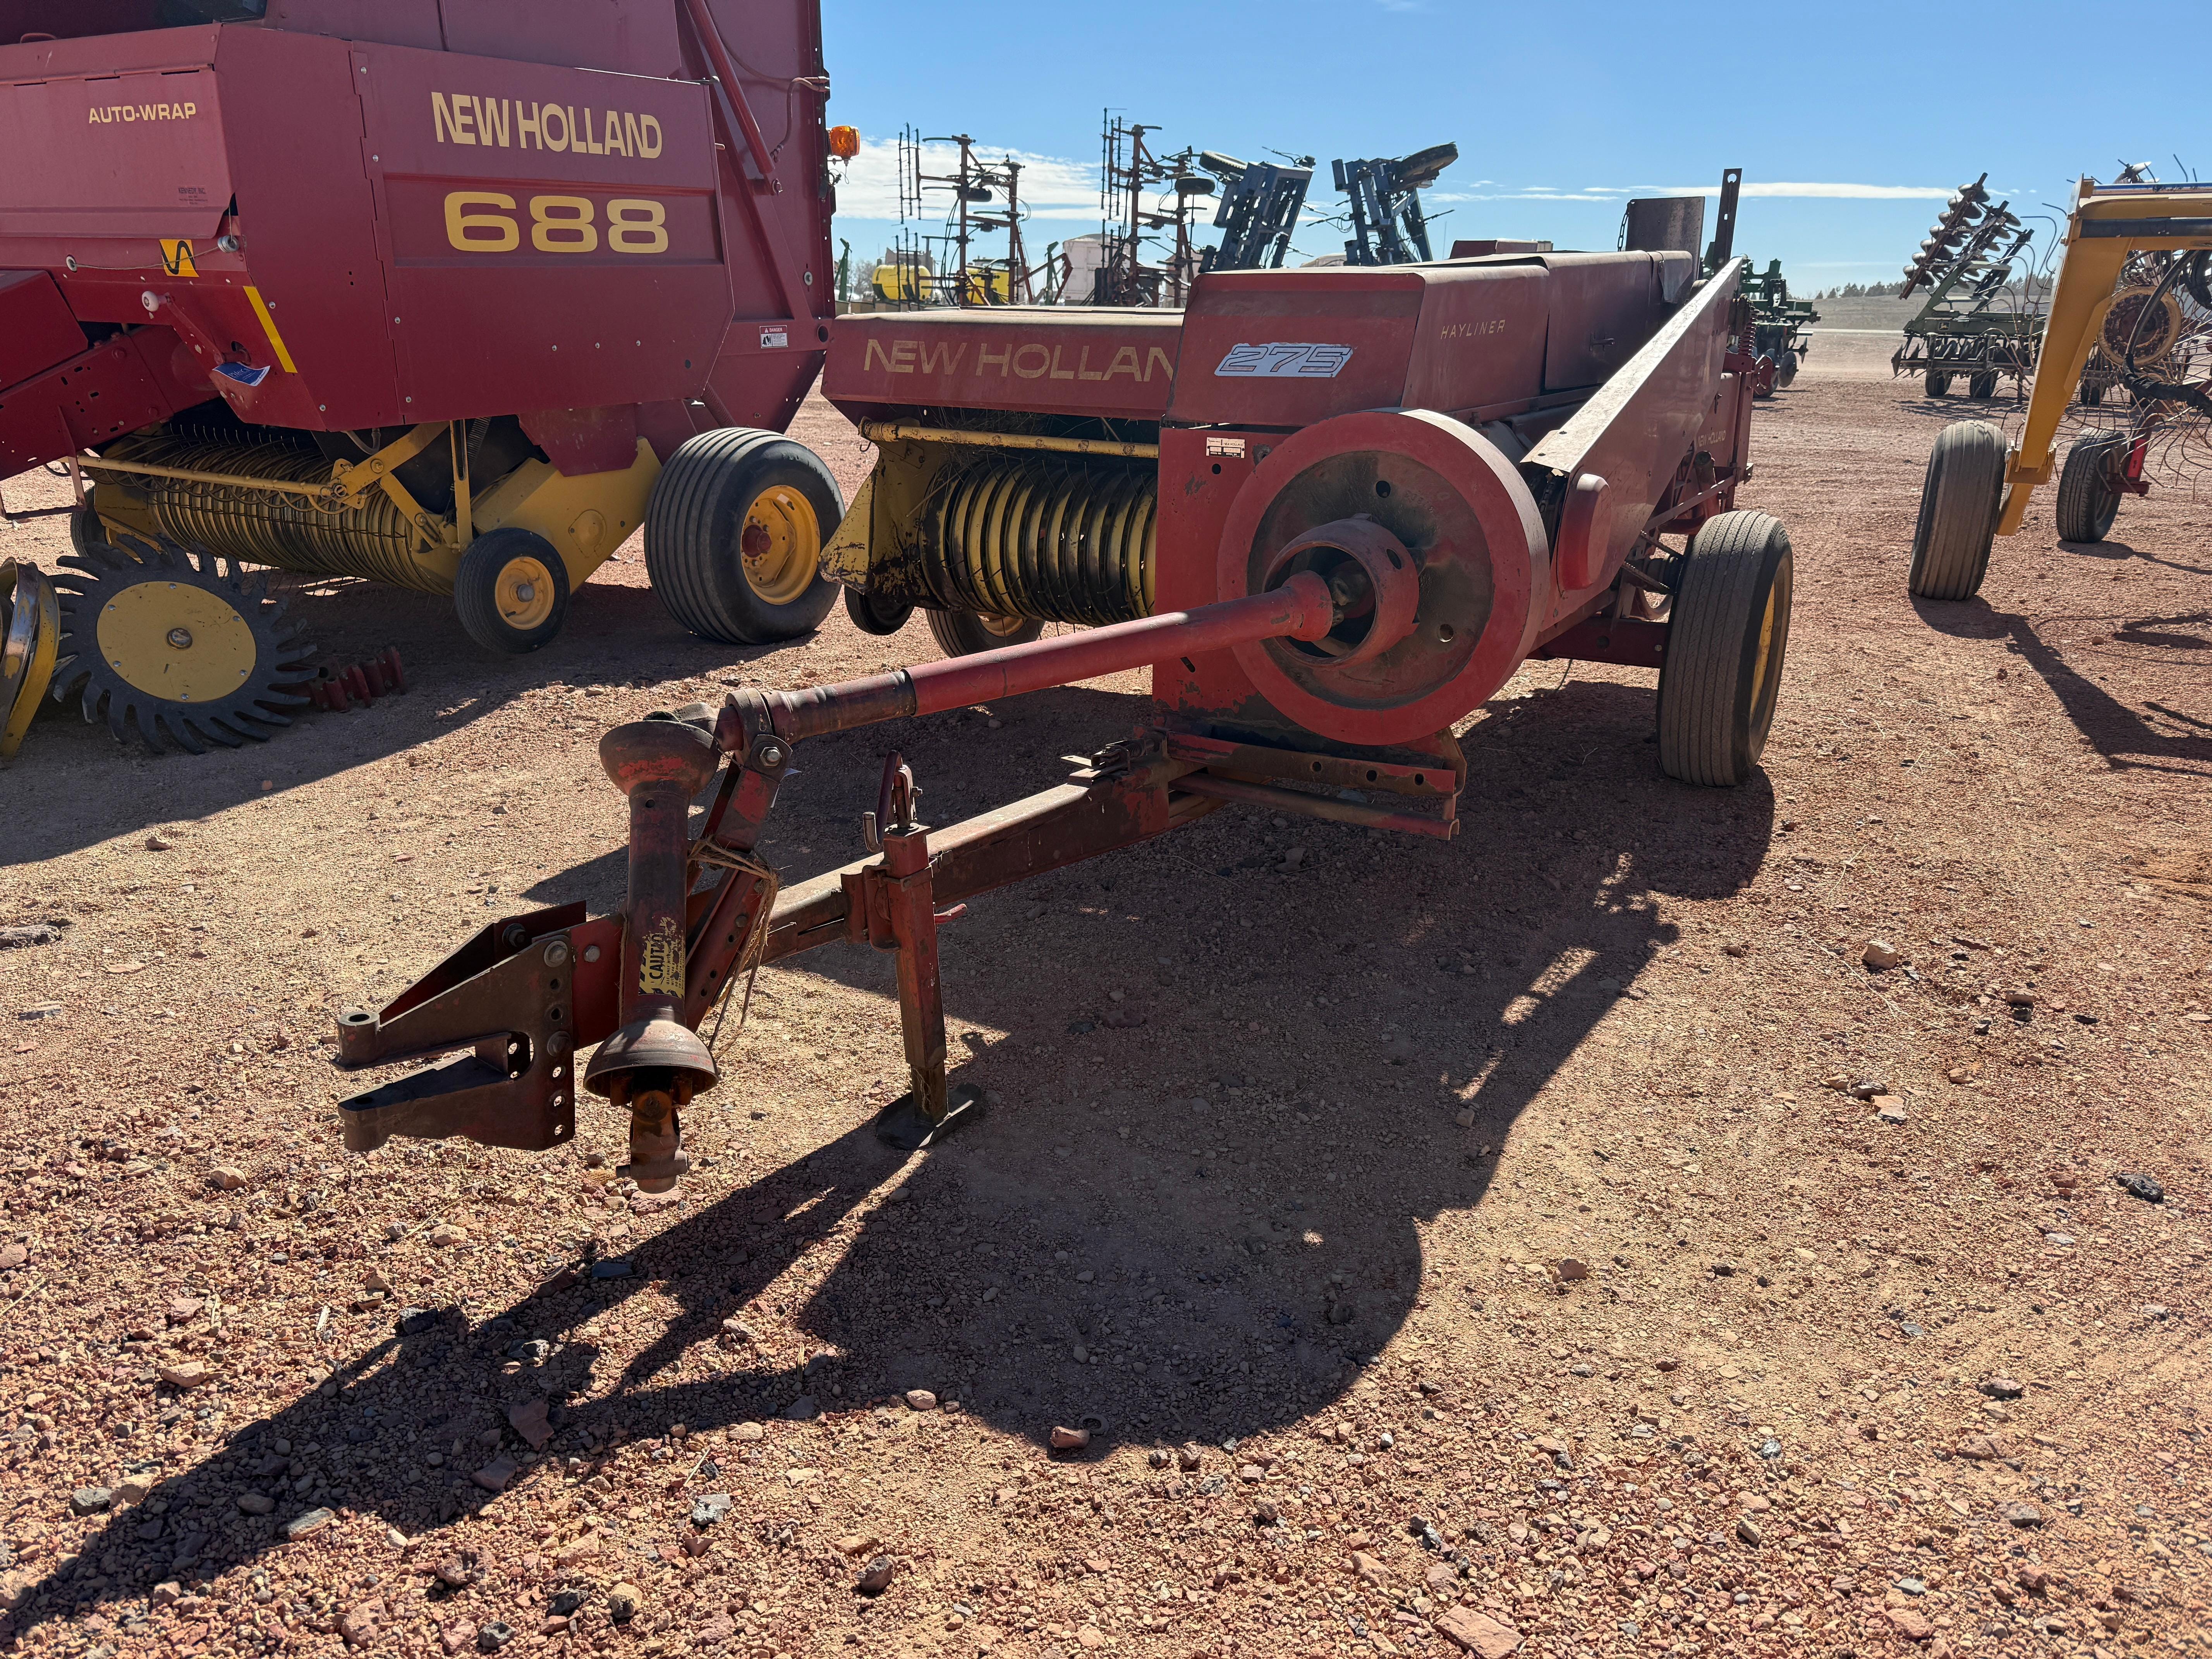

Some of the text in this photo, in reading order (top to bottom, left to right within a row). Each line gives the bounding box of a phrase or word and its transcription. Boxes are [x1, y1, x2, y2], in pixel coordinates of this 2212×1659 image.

[89, 102, 196, 124] AUTO-WRAP
[431, 91, 662, 159] NEW HOLLAND
[444, 191, 669, 254] 688
[1441, 319, 1506, 340] HAYLINER
[864, 339, 1175, 381] NEW HOLLAN
[1219, 346, 1352, 373] 275
[1697, 430, 1726, 447] NEW HOLLAND
[649, 934, 664, 979] CAUTIO
